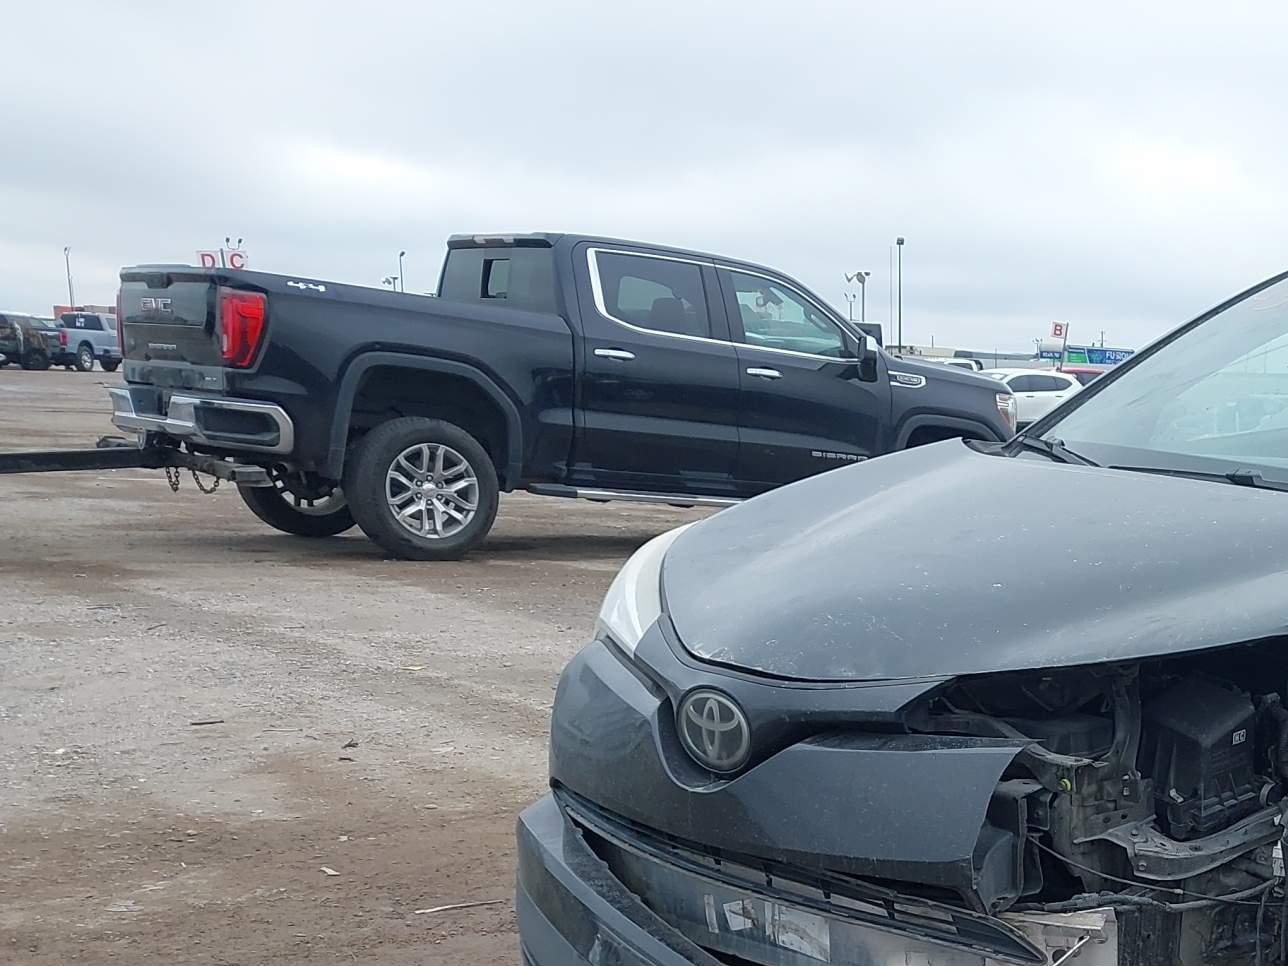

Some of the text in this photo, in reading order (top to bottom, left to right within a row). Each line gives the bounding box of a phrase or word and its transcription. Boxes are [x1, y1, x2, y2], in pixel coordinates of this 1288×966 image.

[200, 253, 215, 268] D
[230, 252, 244, 269] C
[1053, 324, 1063, 336] B
